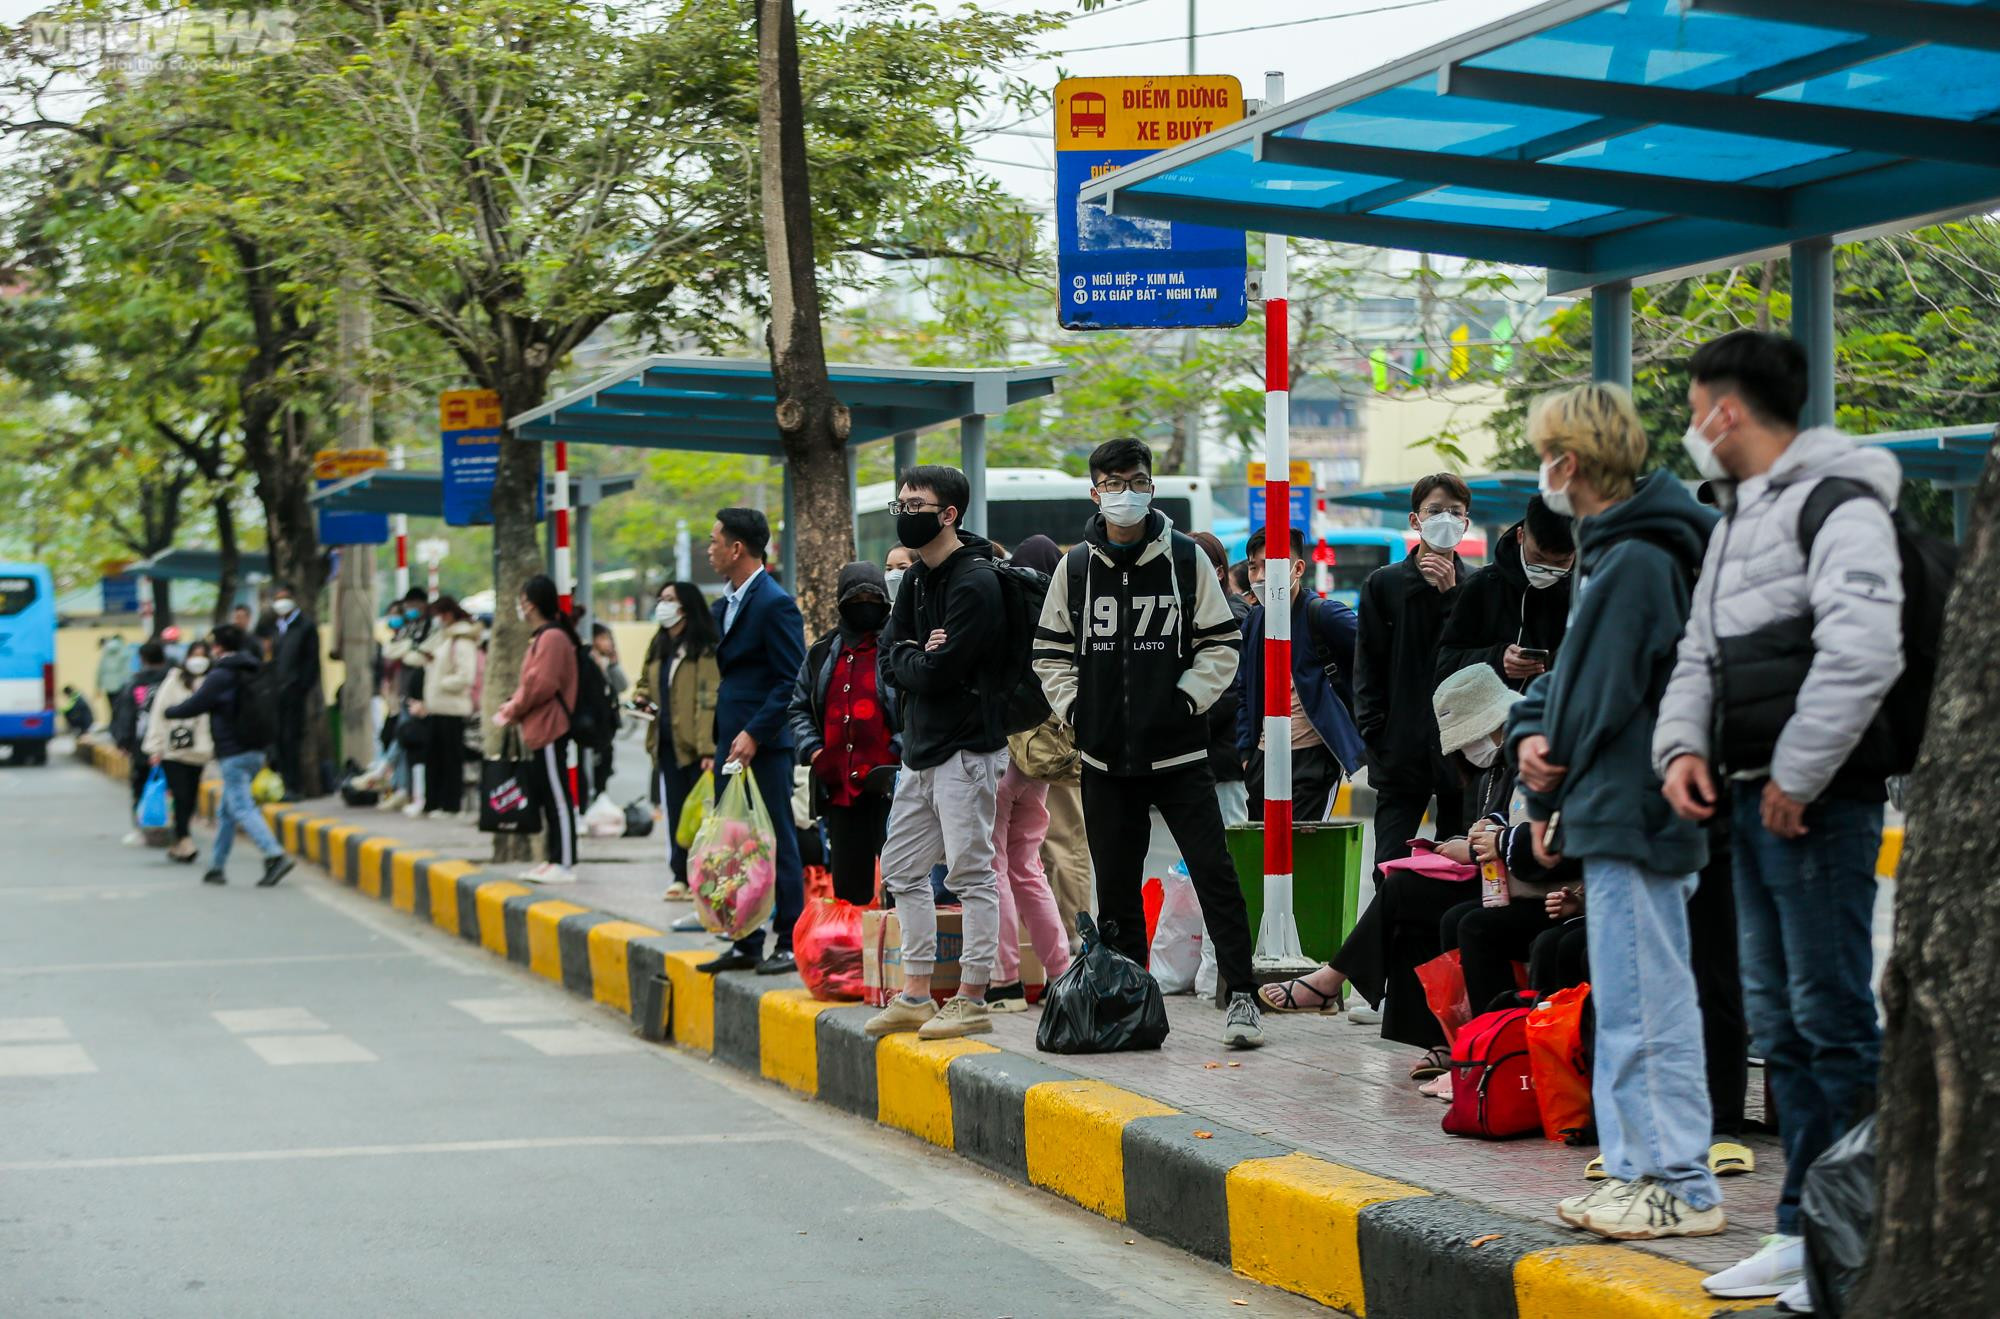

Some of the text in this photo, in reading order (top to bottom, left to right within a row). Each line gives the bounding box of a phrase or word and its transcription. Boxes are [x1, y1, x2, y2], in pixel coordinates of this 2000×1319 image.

[1123, 80, 1228, 109] ĐIỂM DỪNG
[1137, 116, 1213, 142] XE BUÝT
[1092, 272, 1112, 286] NGŨ
[1115, 271, 1138, 287] HIỆP
[1147, 273, 1166, 285] KIM
[1092, 290, 1106, 301] BX
[1109, 286, 1133, 301] GIÁP
[1137, 285, 1156, 301] BÁT
[1166, 288, 1192, 300] NGHI
[1092, 642, 1116, 651] BUILT
